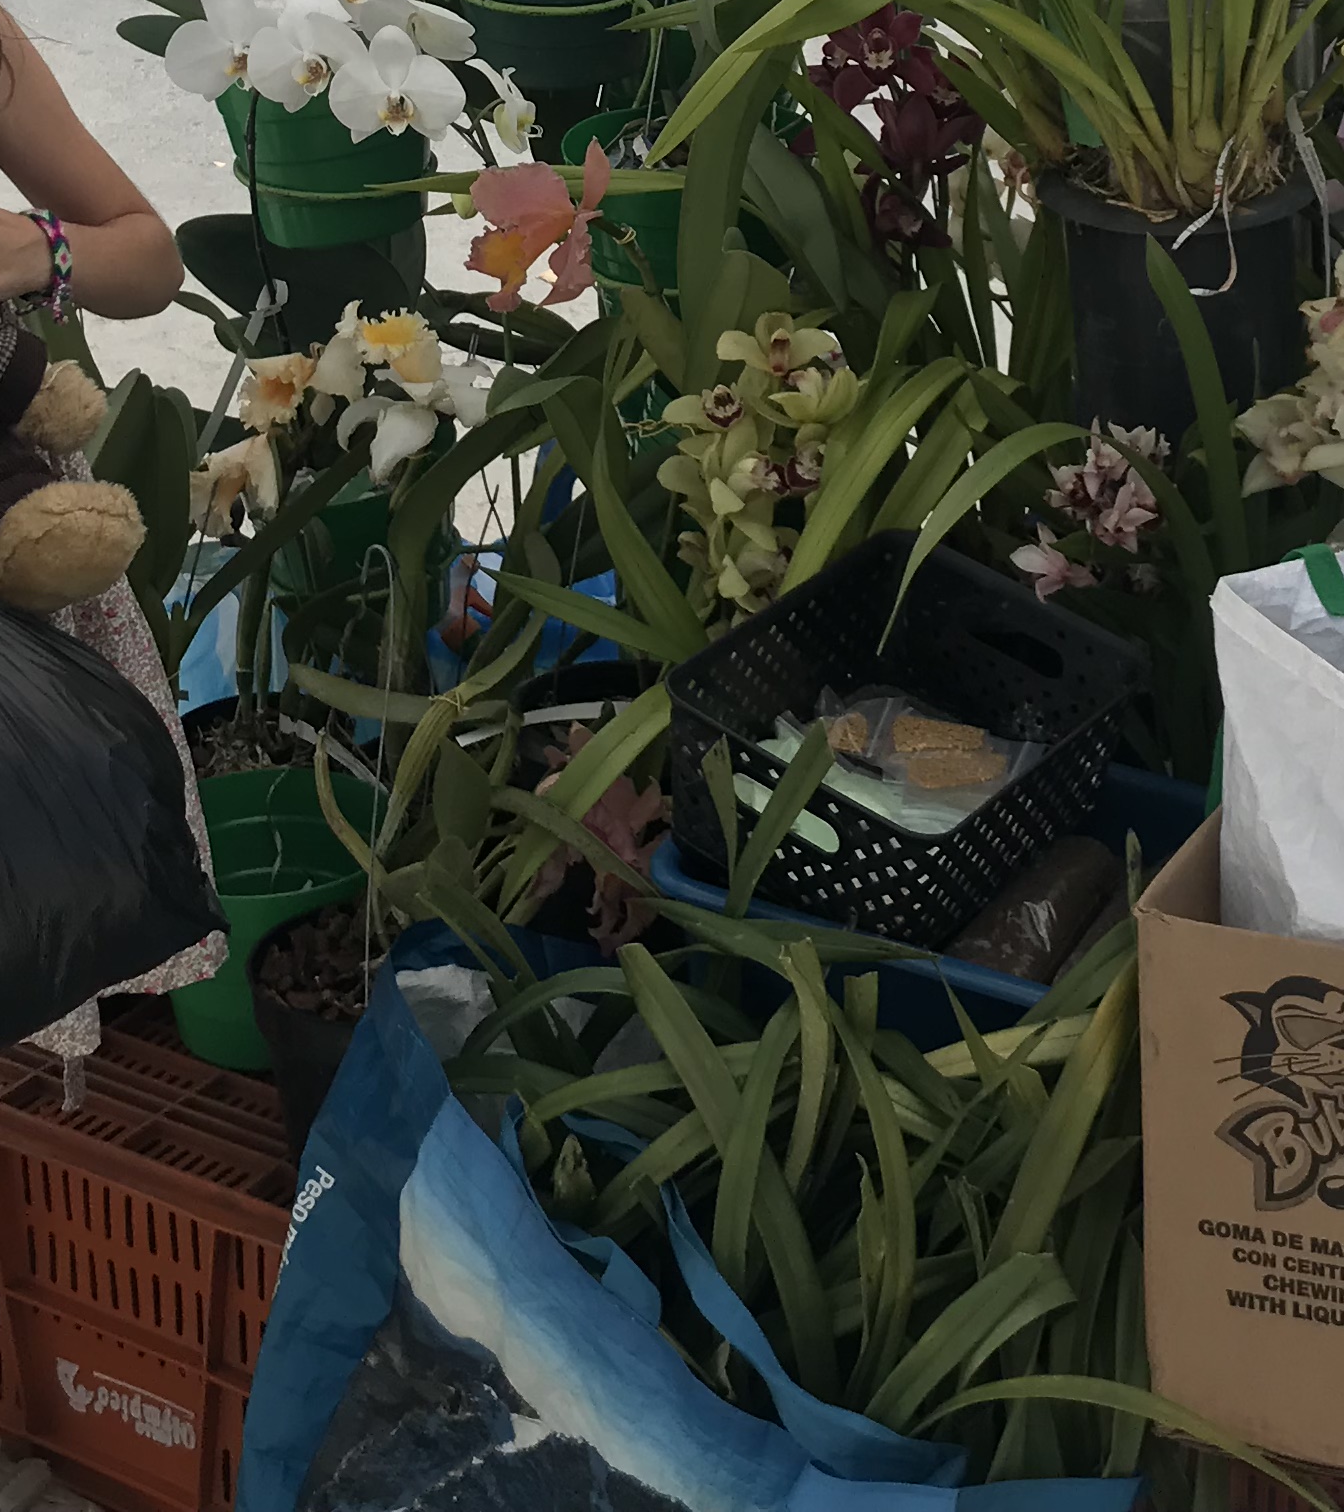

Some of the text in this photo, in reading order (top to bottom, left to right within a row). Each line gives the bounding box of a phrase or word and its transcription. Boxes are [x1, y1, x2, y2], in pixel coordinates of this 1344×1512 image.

[292, 1164, 335, 1223] Peso
[1198, 1219, 1266, 1245] GOMA
[1272, 1229, 1304, 1251] DE
[1232, 1247, 1277, 1269] CON
[1225, 1289, 1286, 1316] WITH
